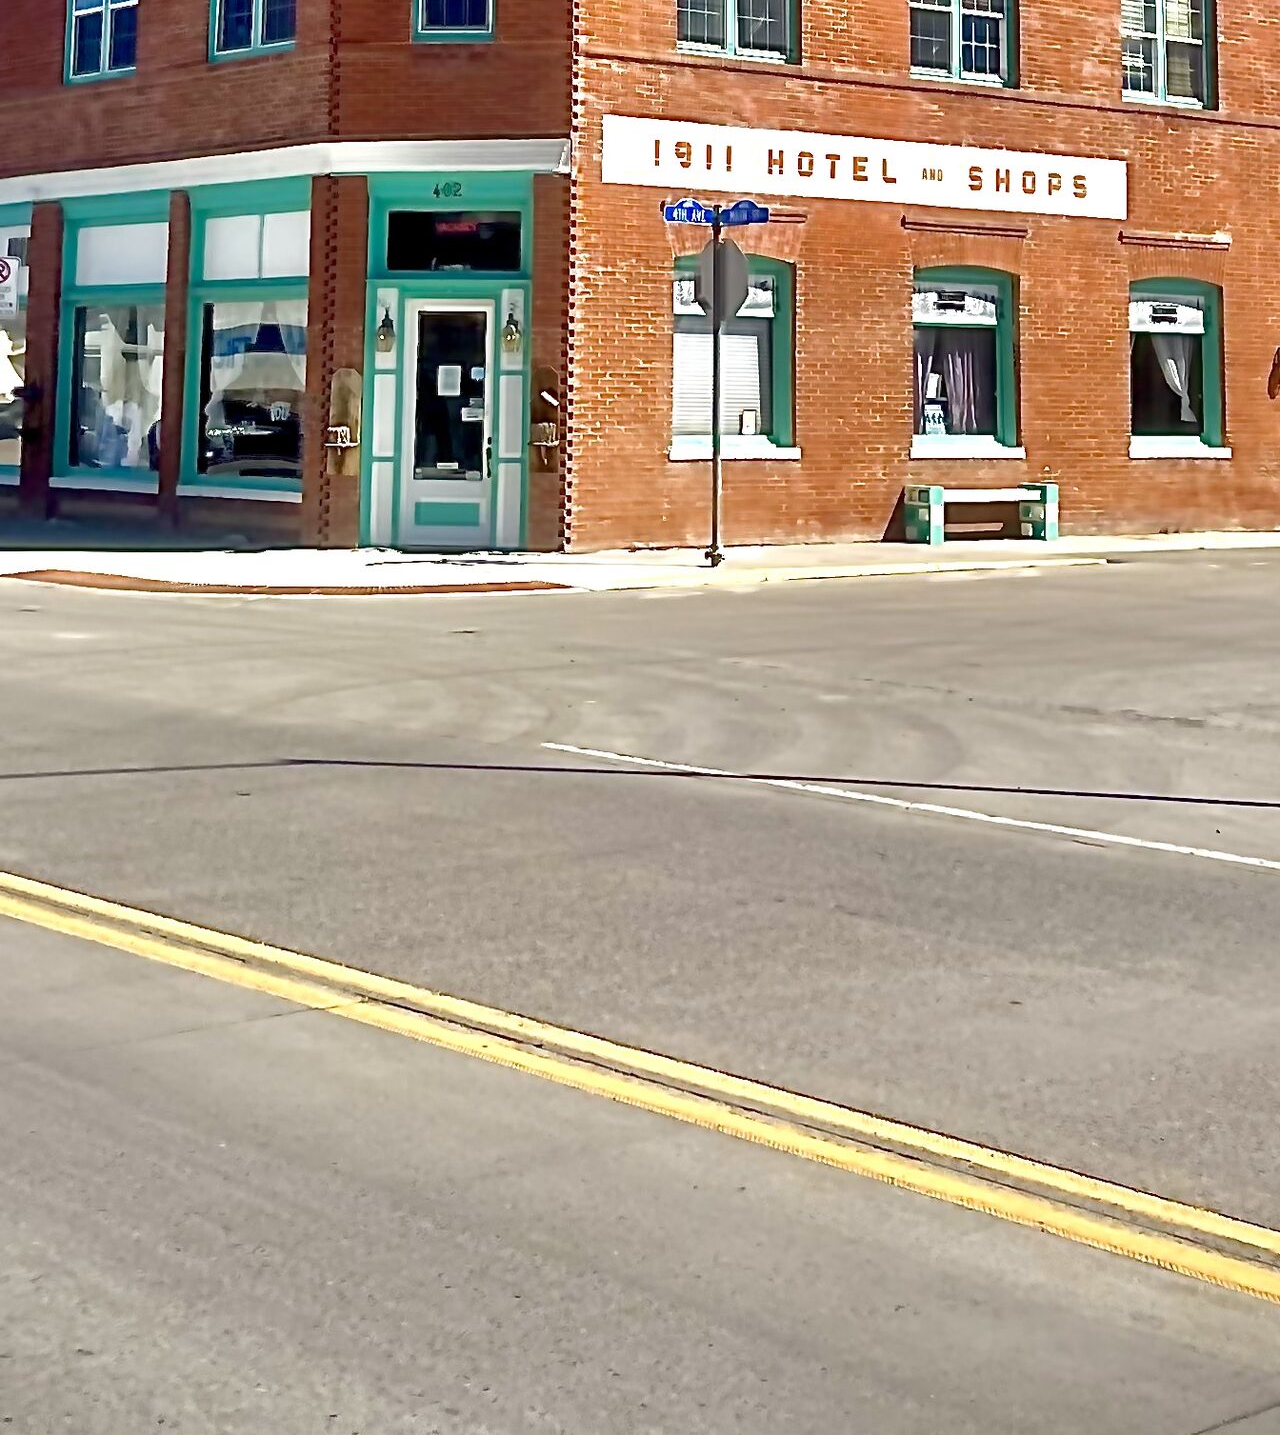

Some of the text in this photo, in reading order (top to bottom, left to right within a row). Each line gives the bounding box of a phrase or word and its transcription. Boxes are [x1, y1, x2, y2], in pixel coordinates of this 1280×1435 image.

[654, 139, 1088, 199] 1911 HOTEL AND SHOPS
[432, 181, 463, 198] 402
[672, 207, 687, 222] 4TH
